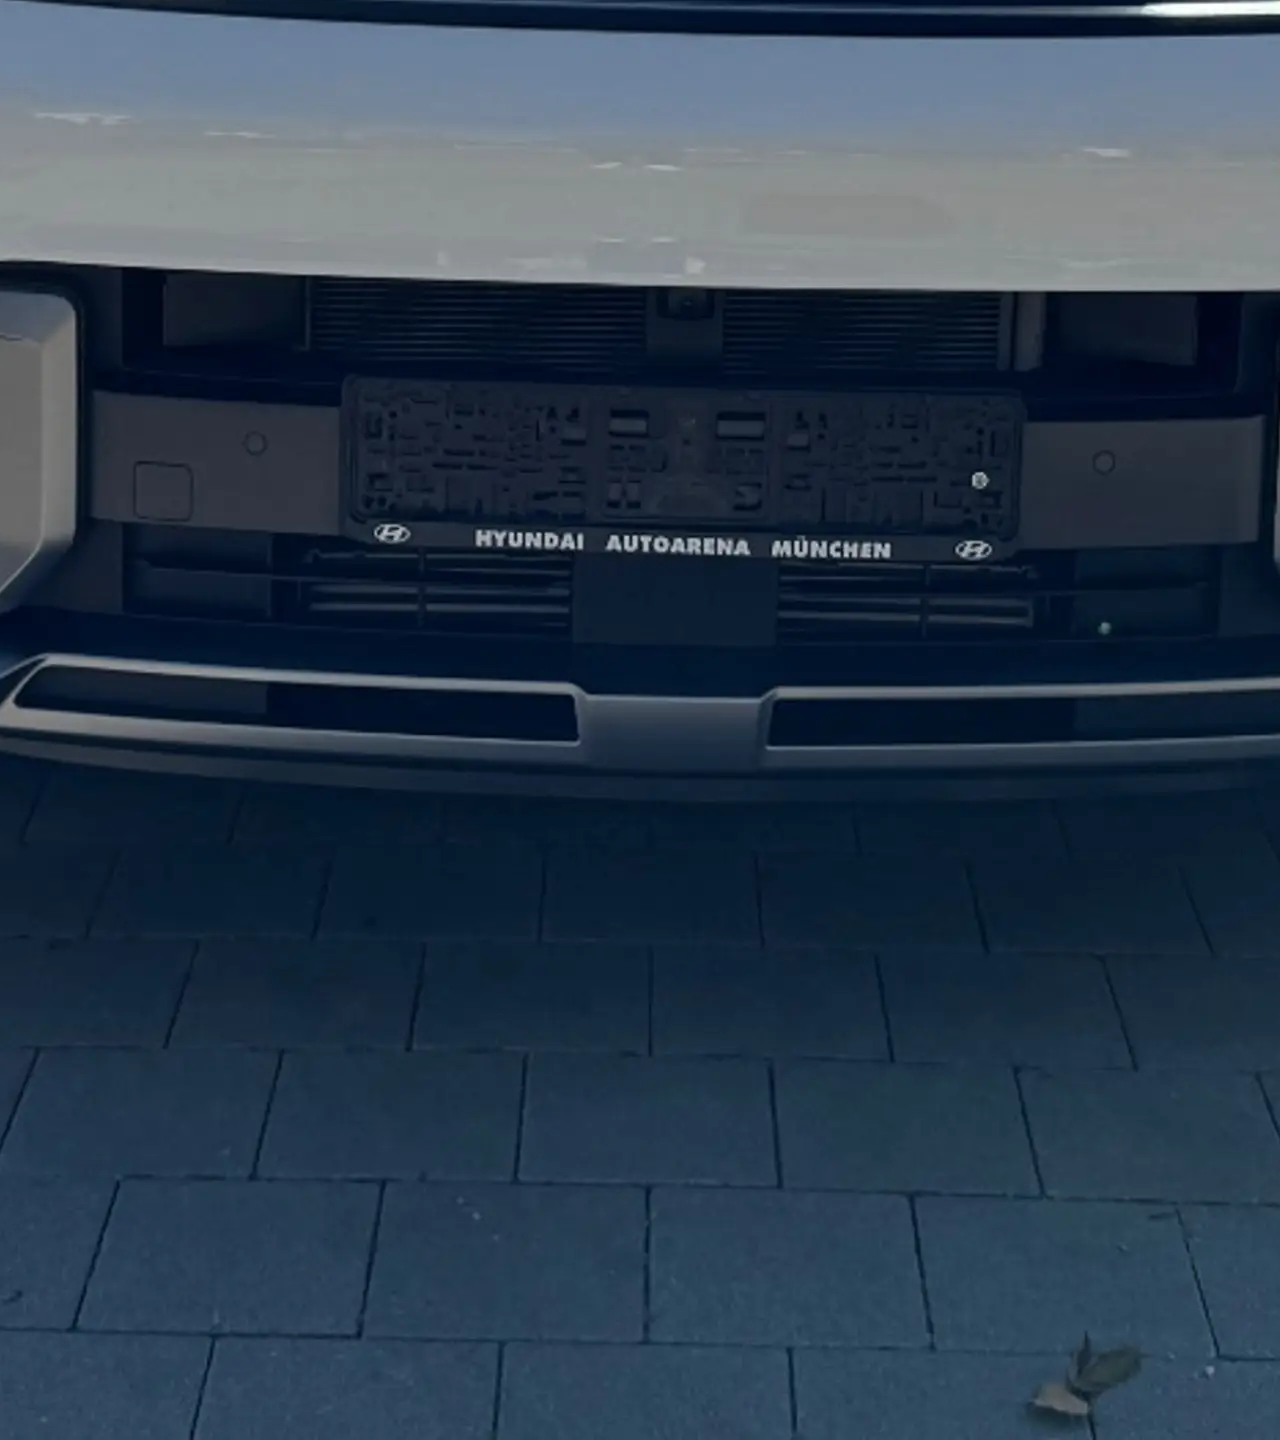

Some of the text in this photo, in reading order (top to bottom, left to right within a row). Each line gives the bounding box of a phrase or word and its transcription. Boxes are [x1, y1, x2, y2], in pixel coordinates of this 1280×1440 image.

[475, 529, 892, 559] HYUNDAI AUTOARENA MÜNCHEN
